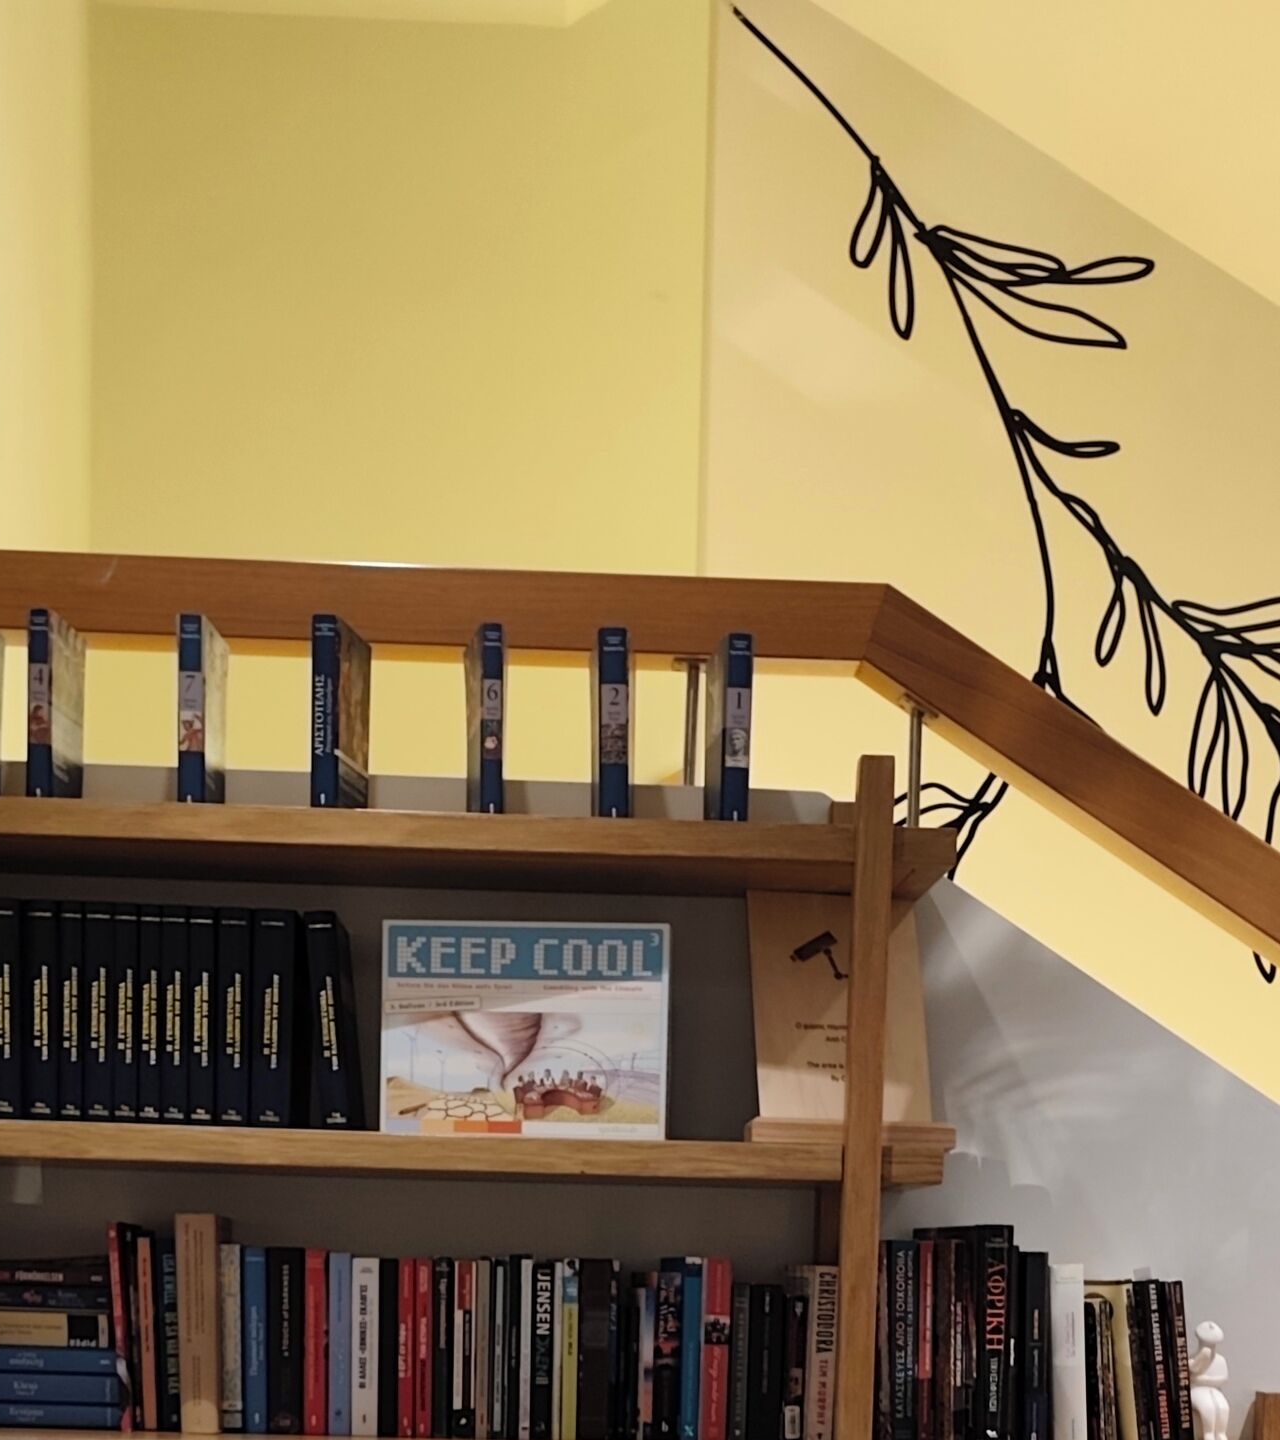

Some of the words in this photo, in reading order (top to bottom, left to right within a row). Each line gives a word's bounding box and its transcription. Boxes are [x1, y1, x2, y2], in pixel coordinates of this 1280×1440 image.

[33, 668, 46, 686] 4
[184, 674, 196, 692] 7
[486, 683, 498, 702] 6
[608, 687, 620, 706] 2
[314, 674, 325, 756] ΑΡΙΣΤΟΤΕΛΗΣ
[734, 692, 742, 711] 1
[396, 936, 517, 975] KEEP
[534, 938, 653, 978] COOL
[536, 1273, 551, 1335] JENSEN
[816, 1272, 836, 1354] CHRISTODORA
[985, 1258, 1005, 1350] ΑΦΡΙΚΗ
[1148, 1283, 1158, 1310] KARIN
[896, 1321, 906, 1346] ΑΠΟ
[1150, 1312, 1162, 1362] SLAUGHTER
[1174, 1314, 1184, 1334] THE
[819, 1358, 828, 1378] TIM
[1176, 1336, 1189, 1386] MISSING
[816, 1380, 827, 1426] MURPHY
[896, 1350, 906, 1418] ΚΑΤΑΣΚΕΥΕΣ
[1158, 1390, 1170, 1440] FORGOTTEN
[1178, 1390, 1190, 1429] SEASON
